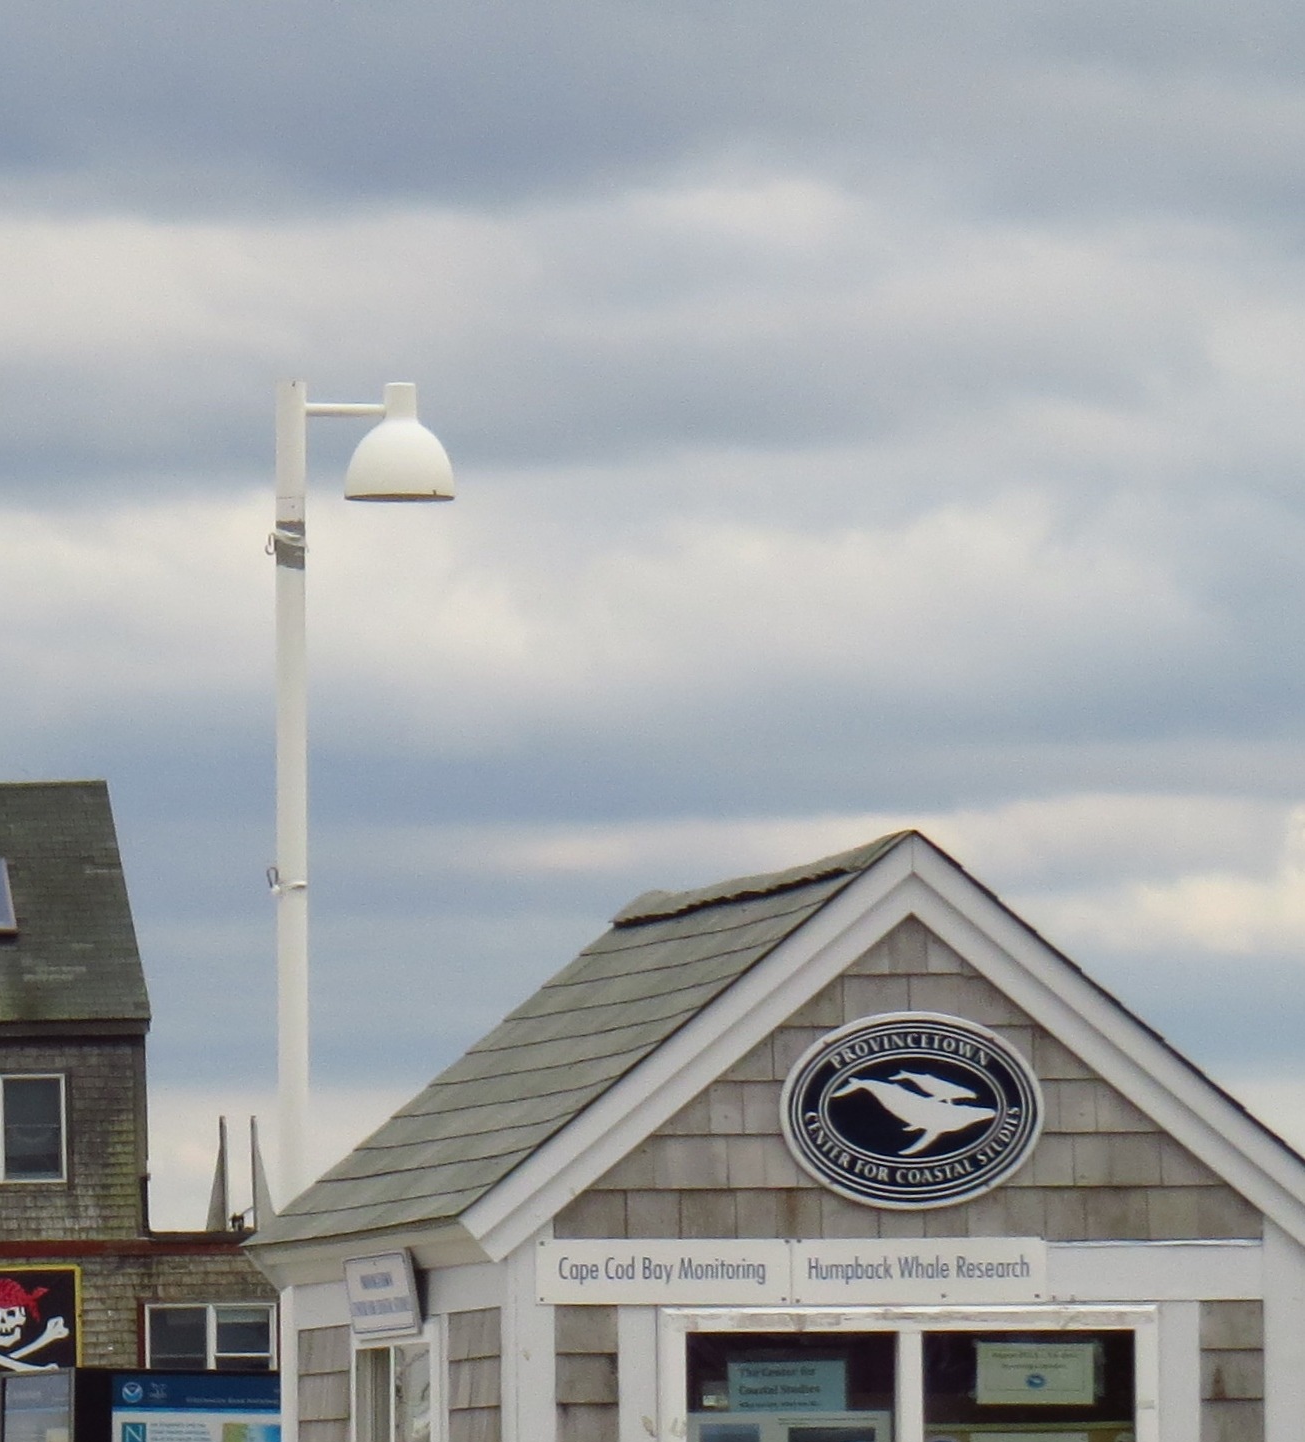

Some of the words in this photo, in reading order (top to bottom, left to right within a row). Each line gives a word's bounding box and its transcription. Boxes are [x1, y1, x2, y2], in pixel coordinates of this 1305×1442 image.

[829, 1033, 991, 1069] PROVINCETOWN
[804, 1110, 850, 1170] CENTER
[854, 1161, 890, 1182] FOR
[895, 1161, 973, 1184] COASTAL
[978, 1106, 1021, 1166] STUDIES
[557, 1257, 599, 1284] Cape
[605, 1257, 636, 1280] Cod
[642, 1257, 672, 1285] Bay
[678, 1257, 766, 1285] Monitoring
[807, 1257, 893, 1284] Humpback
[897, 1256, 950, 1280] Whale
[956, 1254, 1031, 1279] Research
